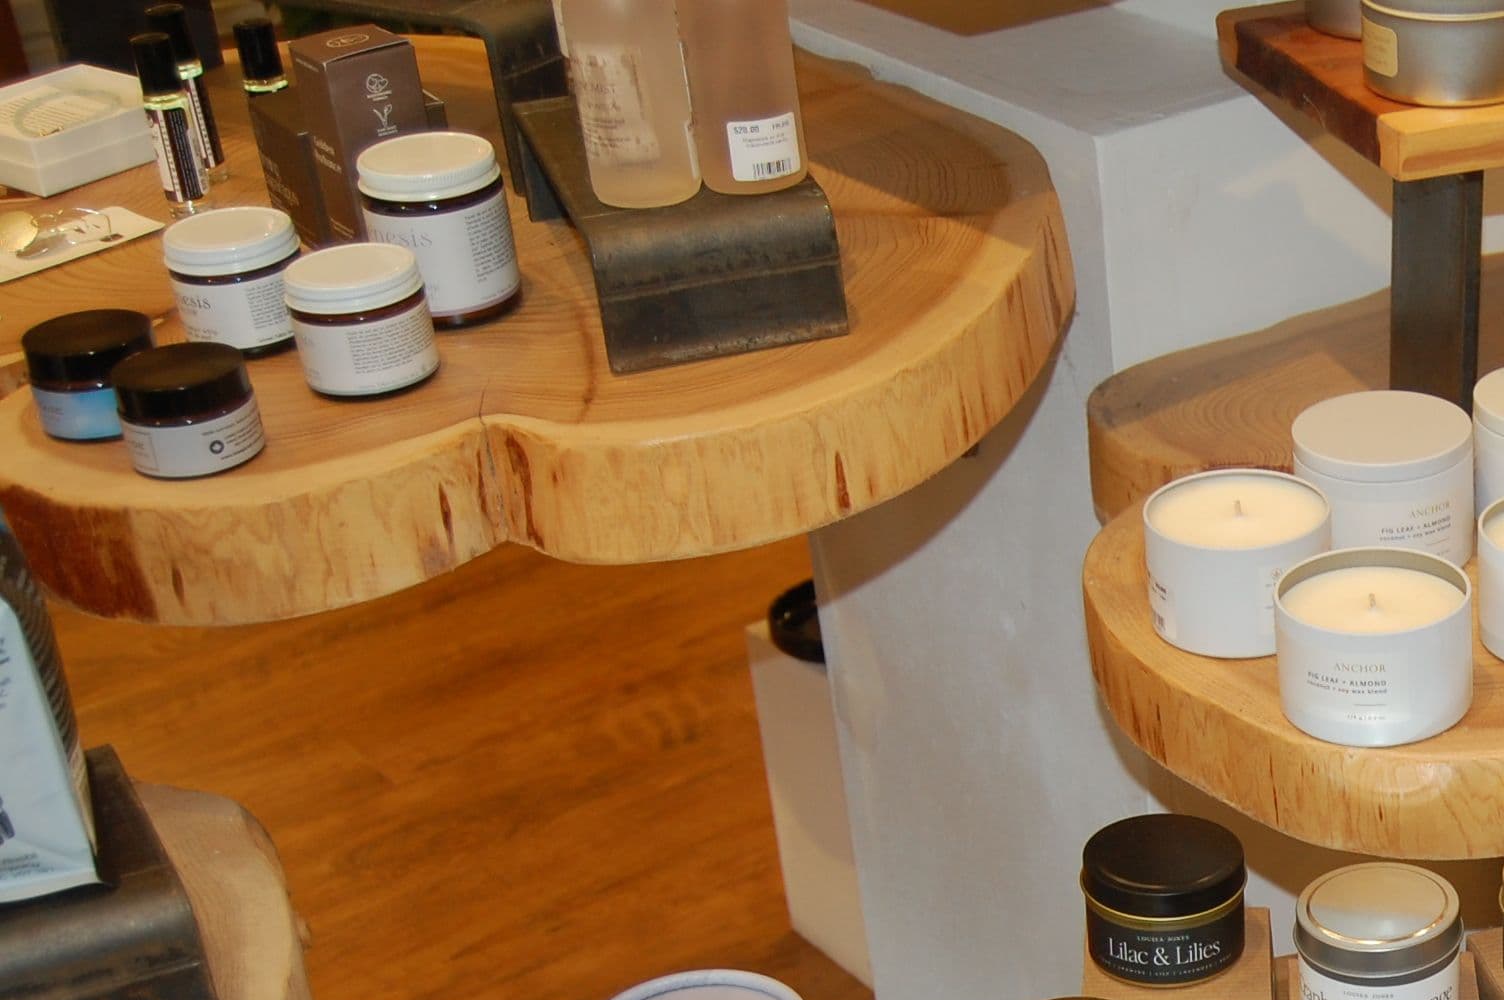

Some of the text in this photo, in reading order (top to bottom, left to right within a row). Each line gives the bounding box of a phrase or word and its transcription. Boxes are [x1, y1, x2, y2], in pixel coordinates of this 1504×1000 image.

[1409, 501, 1451, 518] ANCHOR
[1334, 662, 1387, 673] ANCHOR
[1320, 673, 1339, 684] LEAF
[1109, 937, 1221, 966] Lilac & Lilies
[1343, 990, 1369, 999] LOUISA
